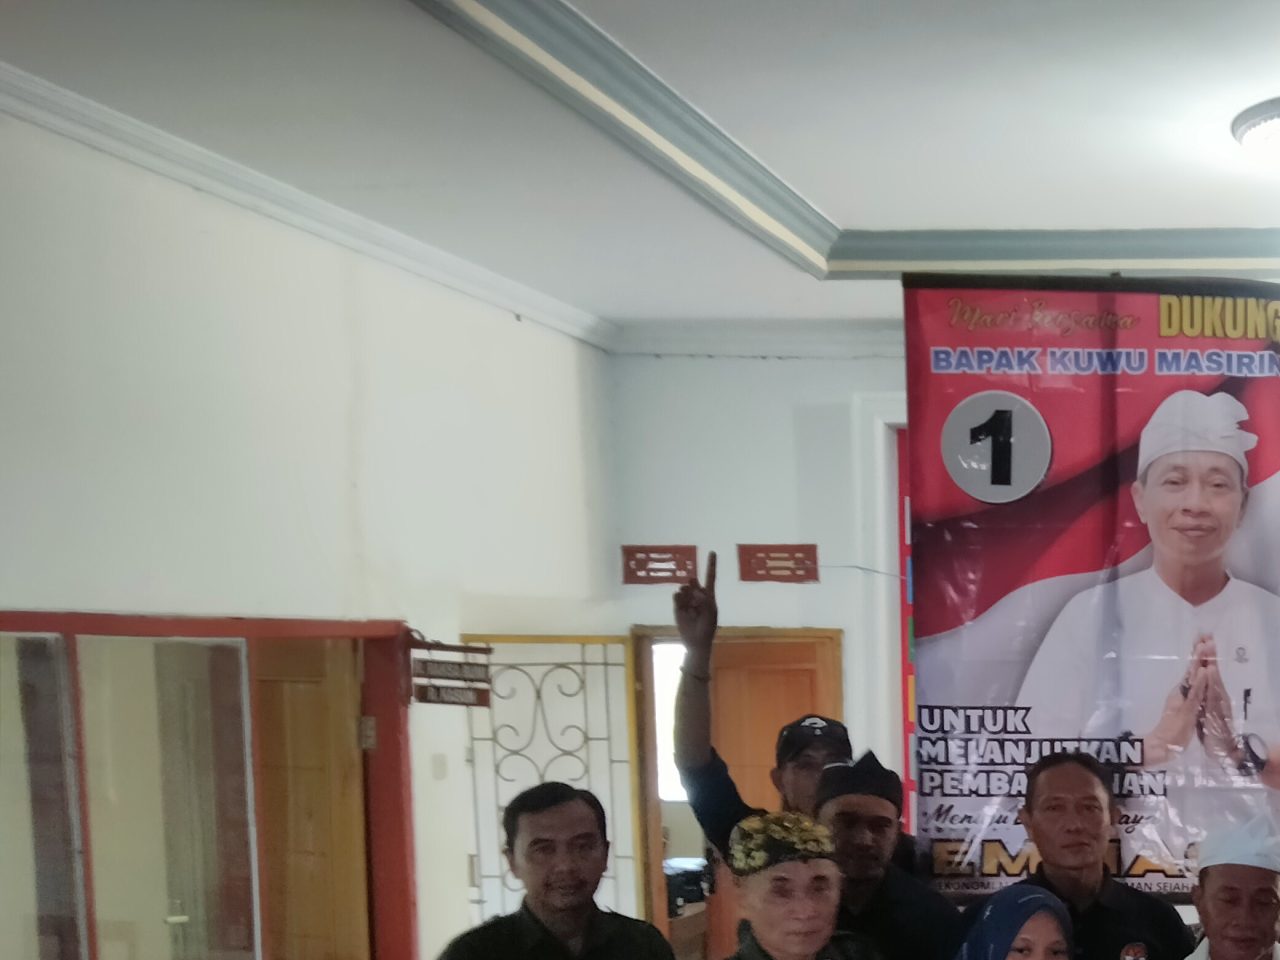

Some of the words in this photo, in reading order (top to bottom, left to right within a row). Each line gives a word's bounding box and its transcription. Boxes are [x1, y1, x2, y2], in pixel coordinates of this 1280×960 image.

[931, 346, 1040, 375] BAPAK
[1049, 348, 1147, 375] KUWU
[969, 409, 1013, 486] 1
[920, 706, 1030, 733] UNTUK
